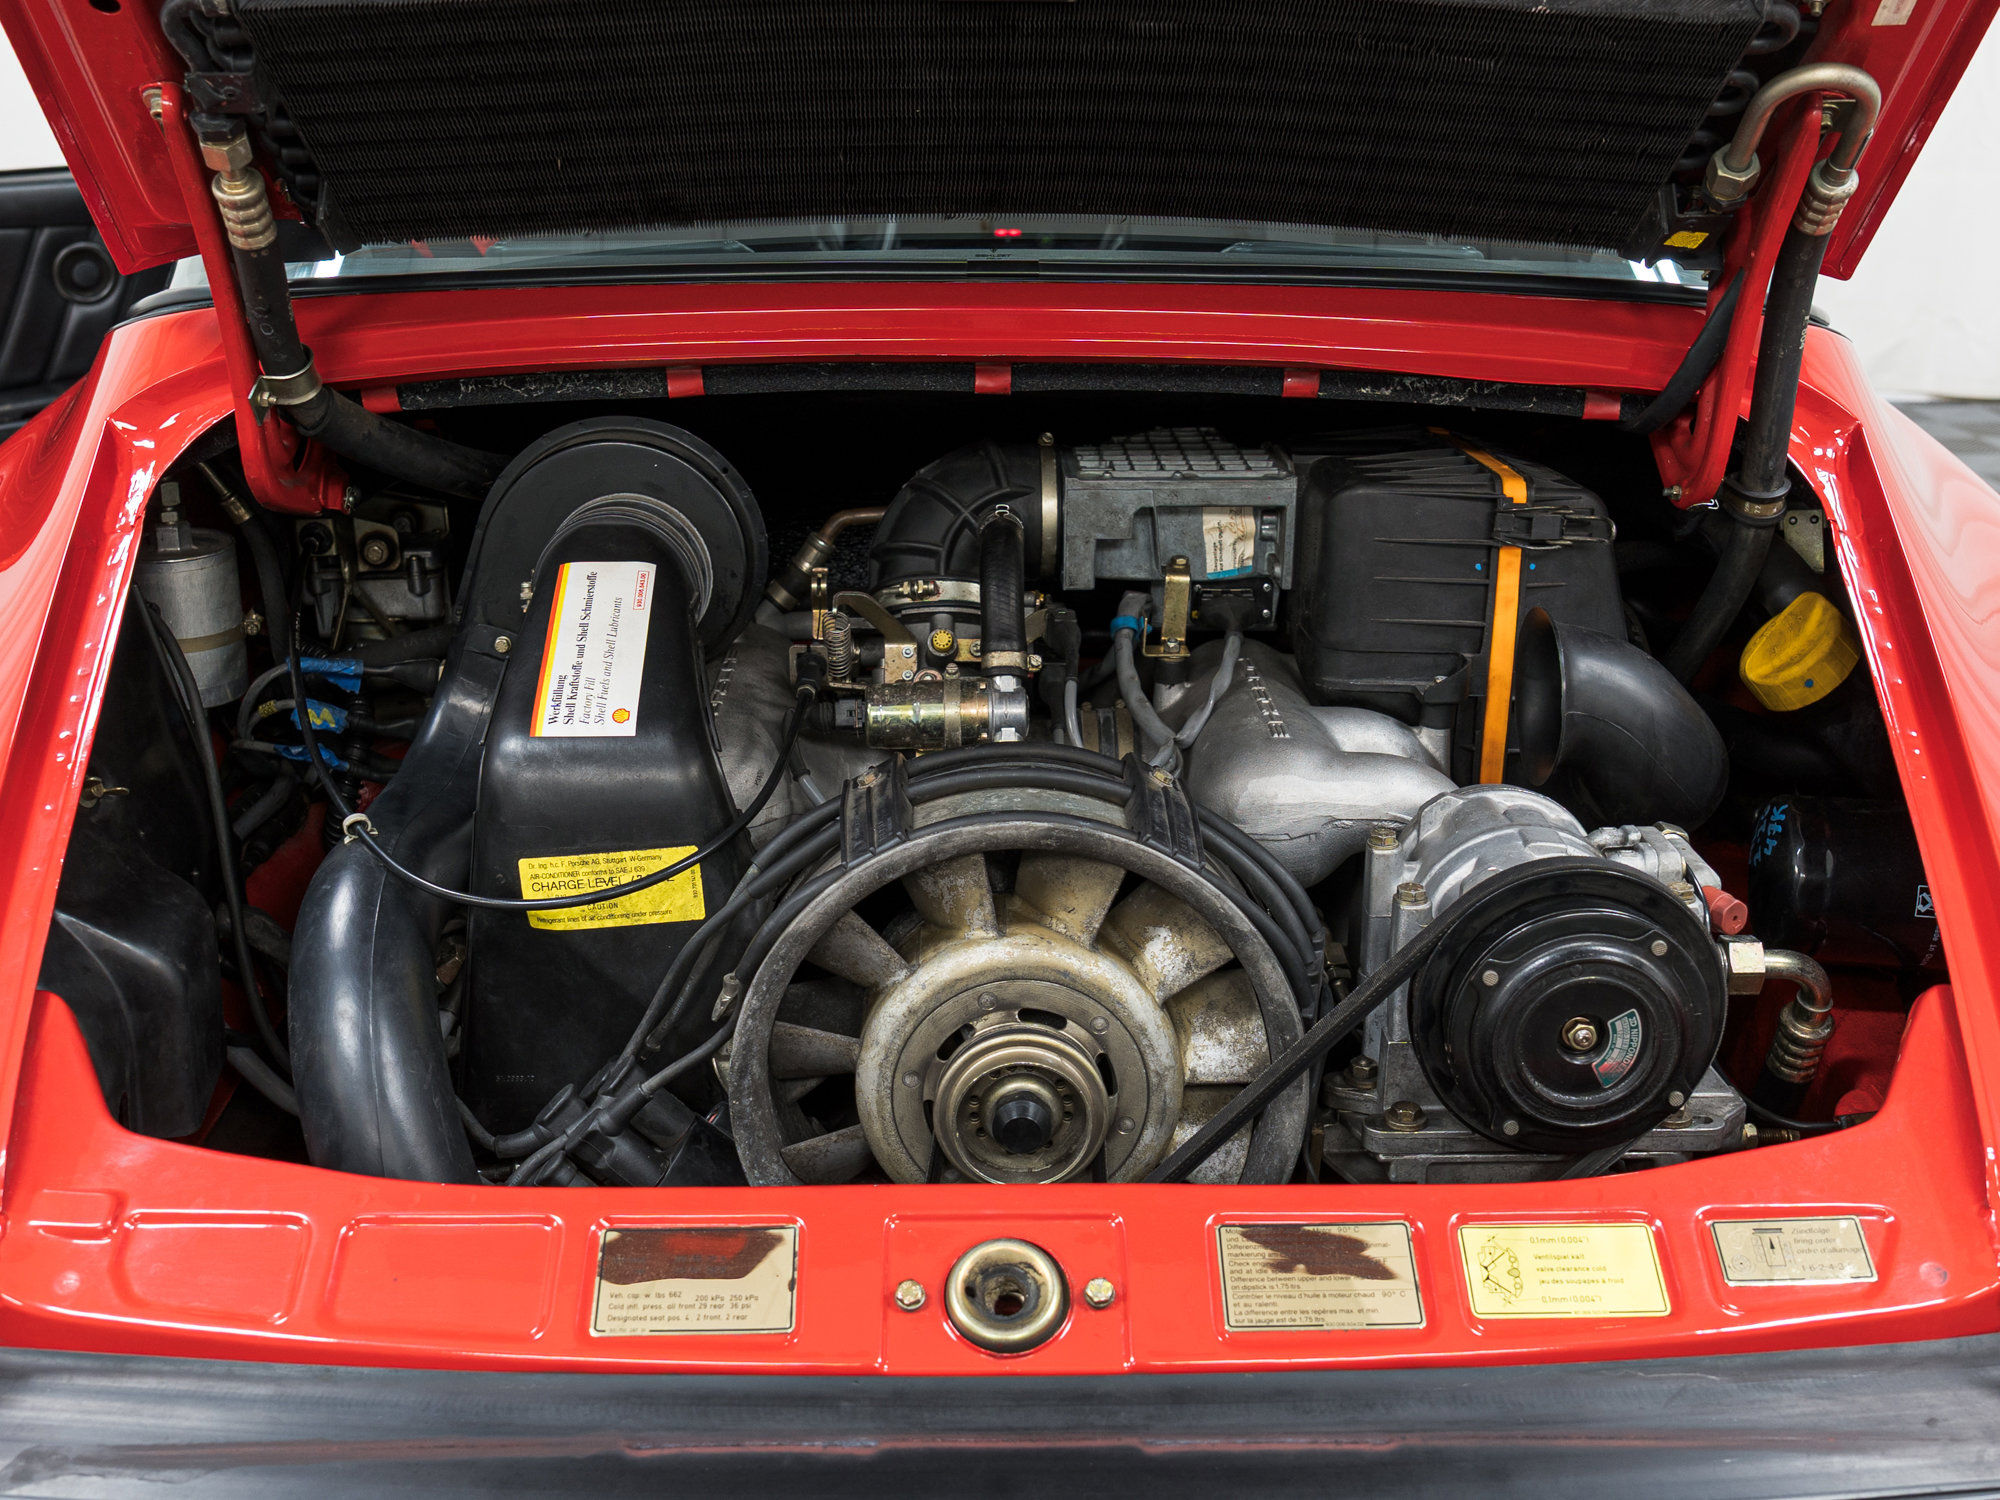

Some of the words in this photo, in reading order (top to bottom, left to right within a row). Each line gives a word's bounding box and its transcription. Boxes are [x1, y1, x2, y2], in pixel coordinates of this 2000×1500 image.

[580, 571, 598, 621] Schmierstoffe
[606, 596, 623, 638] Lubricants
[576, 622, 590, 643] Shell
[576, 644, 586, 659] und
[603, 639, 616, 660] Shell
[603, 660, 613, 677] and
[567, 660, 583, 700] Kraftstoffe
[584, 676, 596, 691] Fill
[597, 678, 610, 700] Fuels
[548, 674, 568, 725] Werkfüllung
[563, 702, 576, 725] Shell
[579, 692, 596, 725] Factory
[594, 702, 607, 725] Shell
[568, 859, 589, 867] Porsche
[530, 870, 580, 880] AIR-CONDITIONER
[531, 879, 585, 892] CHARGE
[587, 902, 618, 911] CAUTION
[649, 909, 673, 917] pressure
[1242, 1283, 1266, 1291] dipstick
[608, 1302, 624, 1310] Cold
[695, 1294, 708, 1302] 200
[607, 1314, 648, 1323] Designated
